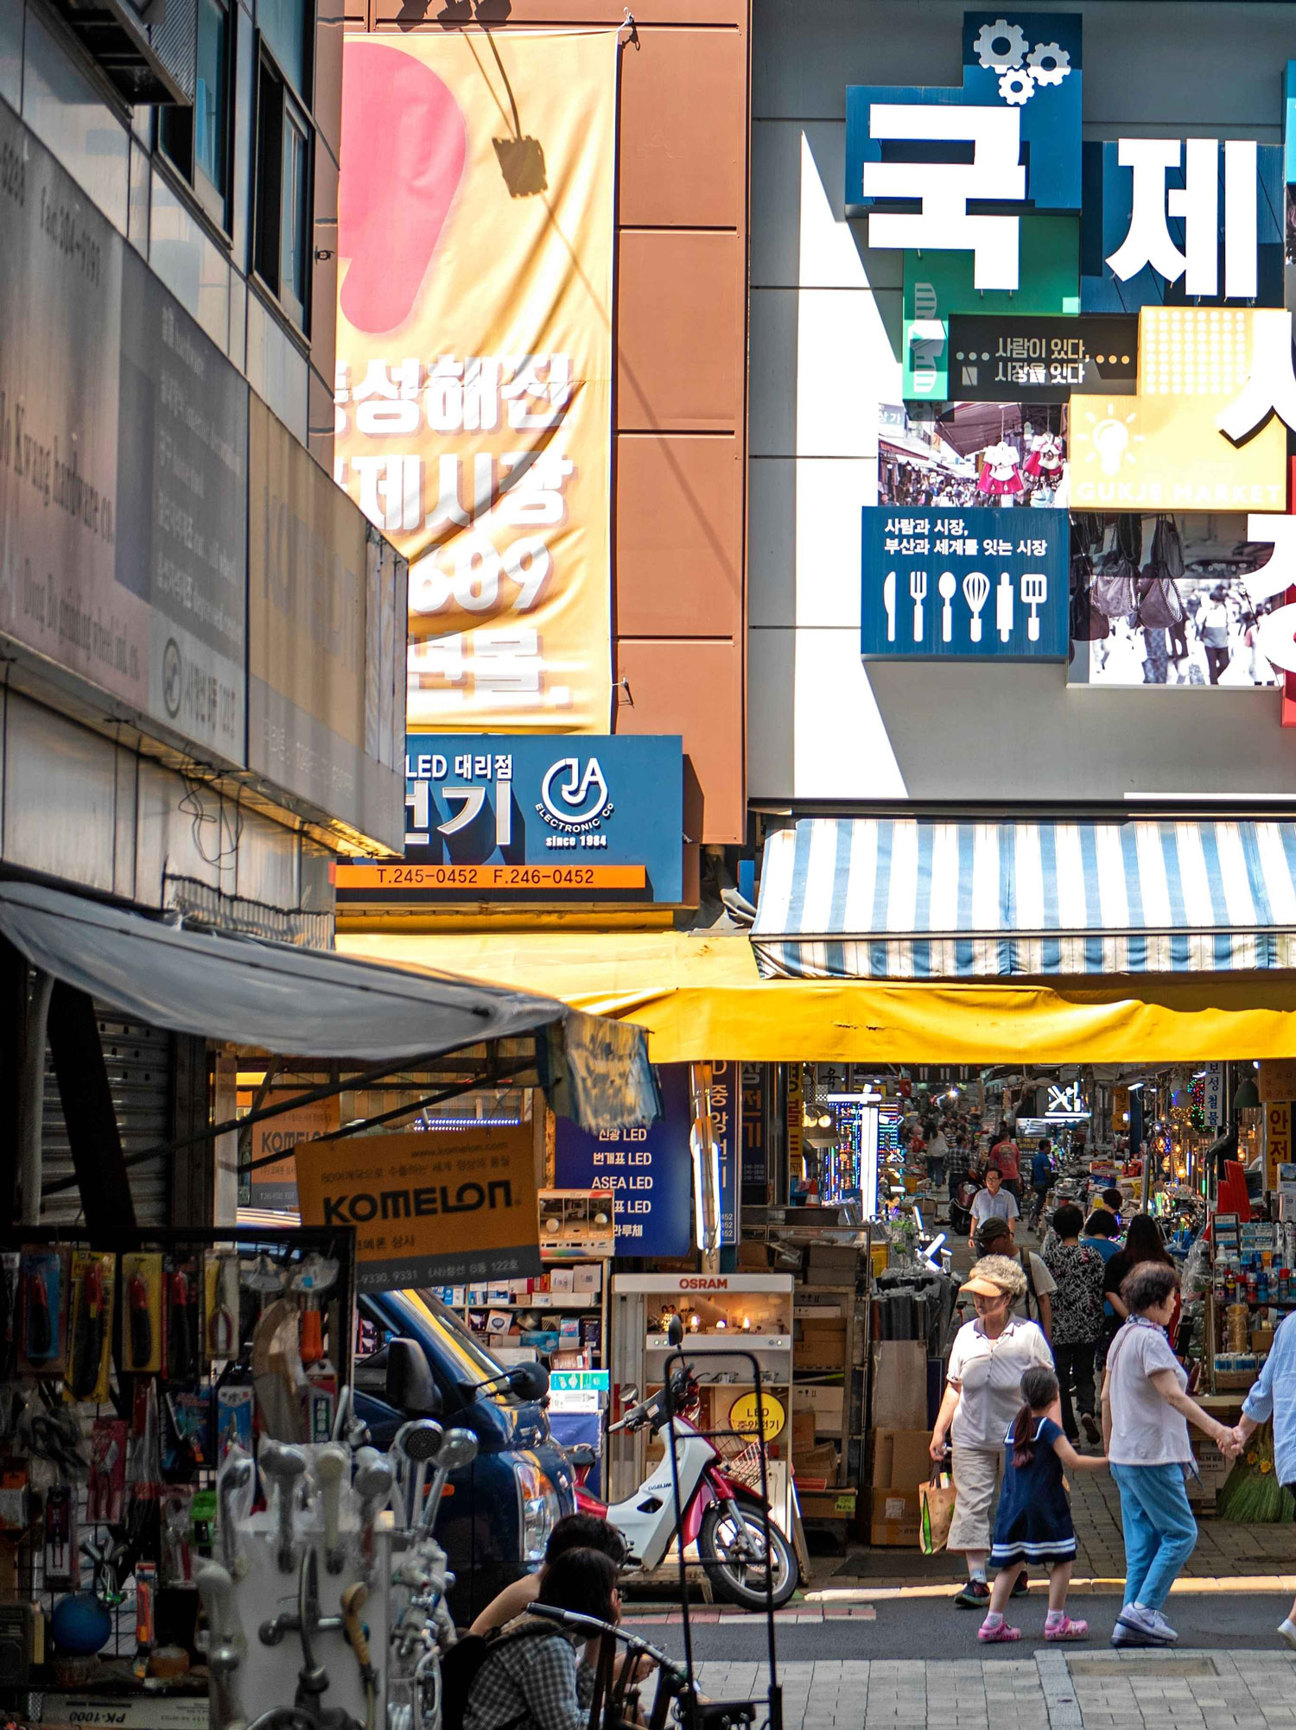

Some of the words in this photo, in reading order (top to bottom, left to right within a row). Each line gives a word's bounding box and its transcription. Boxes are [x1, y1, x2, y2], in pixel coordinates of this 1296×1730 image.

[994, 337, 1046, 359] 사람이
[1050, 338, 1090, 363] 있다,
[994, 361, 1047, 384] 시장을
[334, 353, 572, 433] 성해진
[334, 452, 573, 531] 제시장
[884, 518, 930, 535] 사람과
[934, 519, 969, 537] 시장,
[884, 538, 930, 556] 부산과
[934, 538, 979, 556] 세계를
[983, 538, 1013, 556] 잇는
[1017, 538, 1048, 556] 시장
[454, 754, 513, 780] 대리점
[535, 803, 601, 832] ELECTRONIC
[545, 835, 576, 847] since
[579, 834, 607, 847] 1984
[377, 868, 478, 885] T.245-0452
[493, 868, 595, 885] F.246-0452
[623, 1128, 647, 1141] LED
[593, 1152, 625, 1165] 번개표
[628, 1152, 652, 1165] LED
[591, 1176, 627, 1189] ASEA
[629, 1176, 653, 1189] LED
[323, 1179, 513, 1226] KOMELON
[628, 1200, 652, 1213] LED
[679, 1278, 728, 1289] OSRAM
